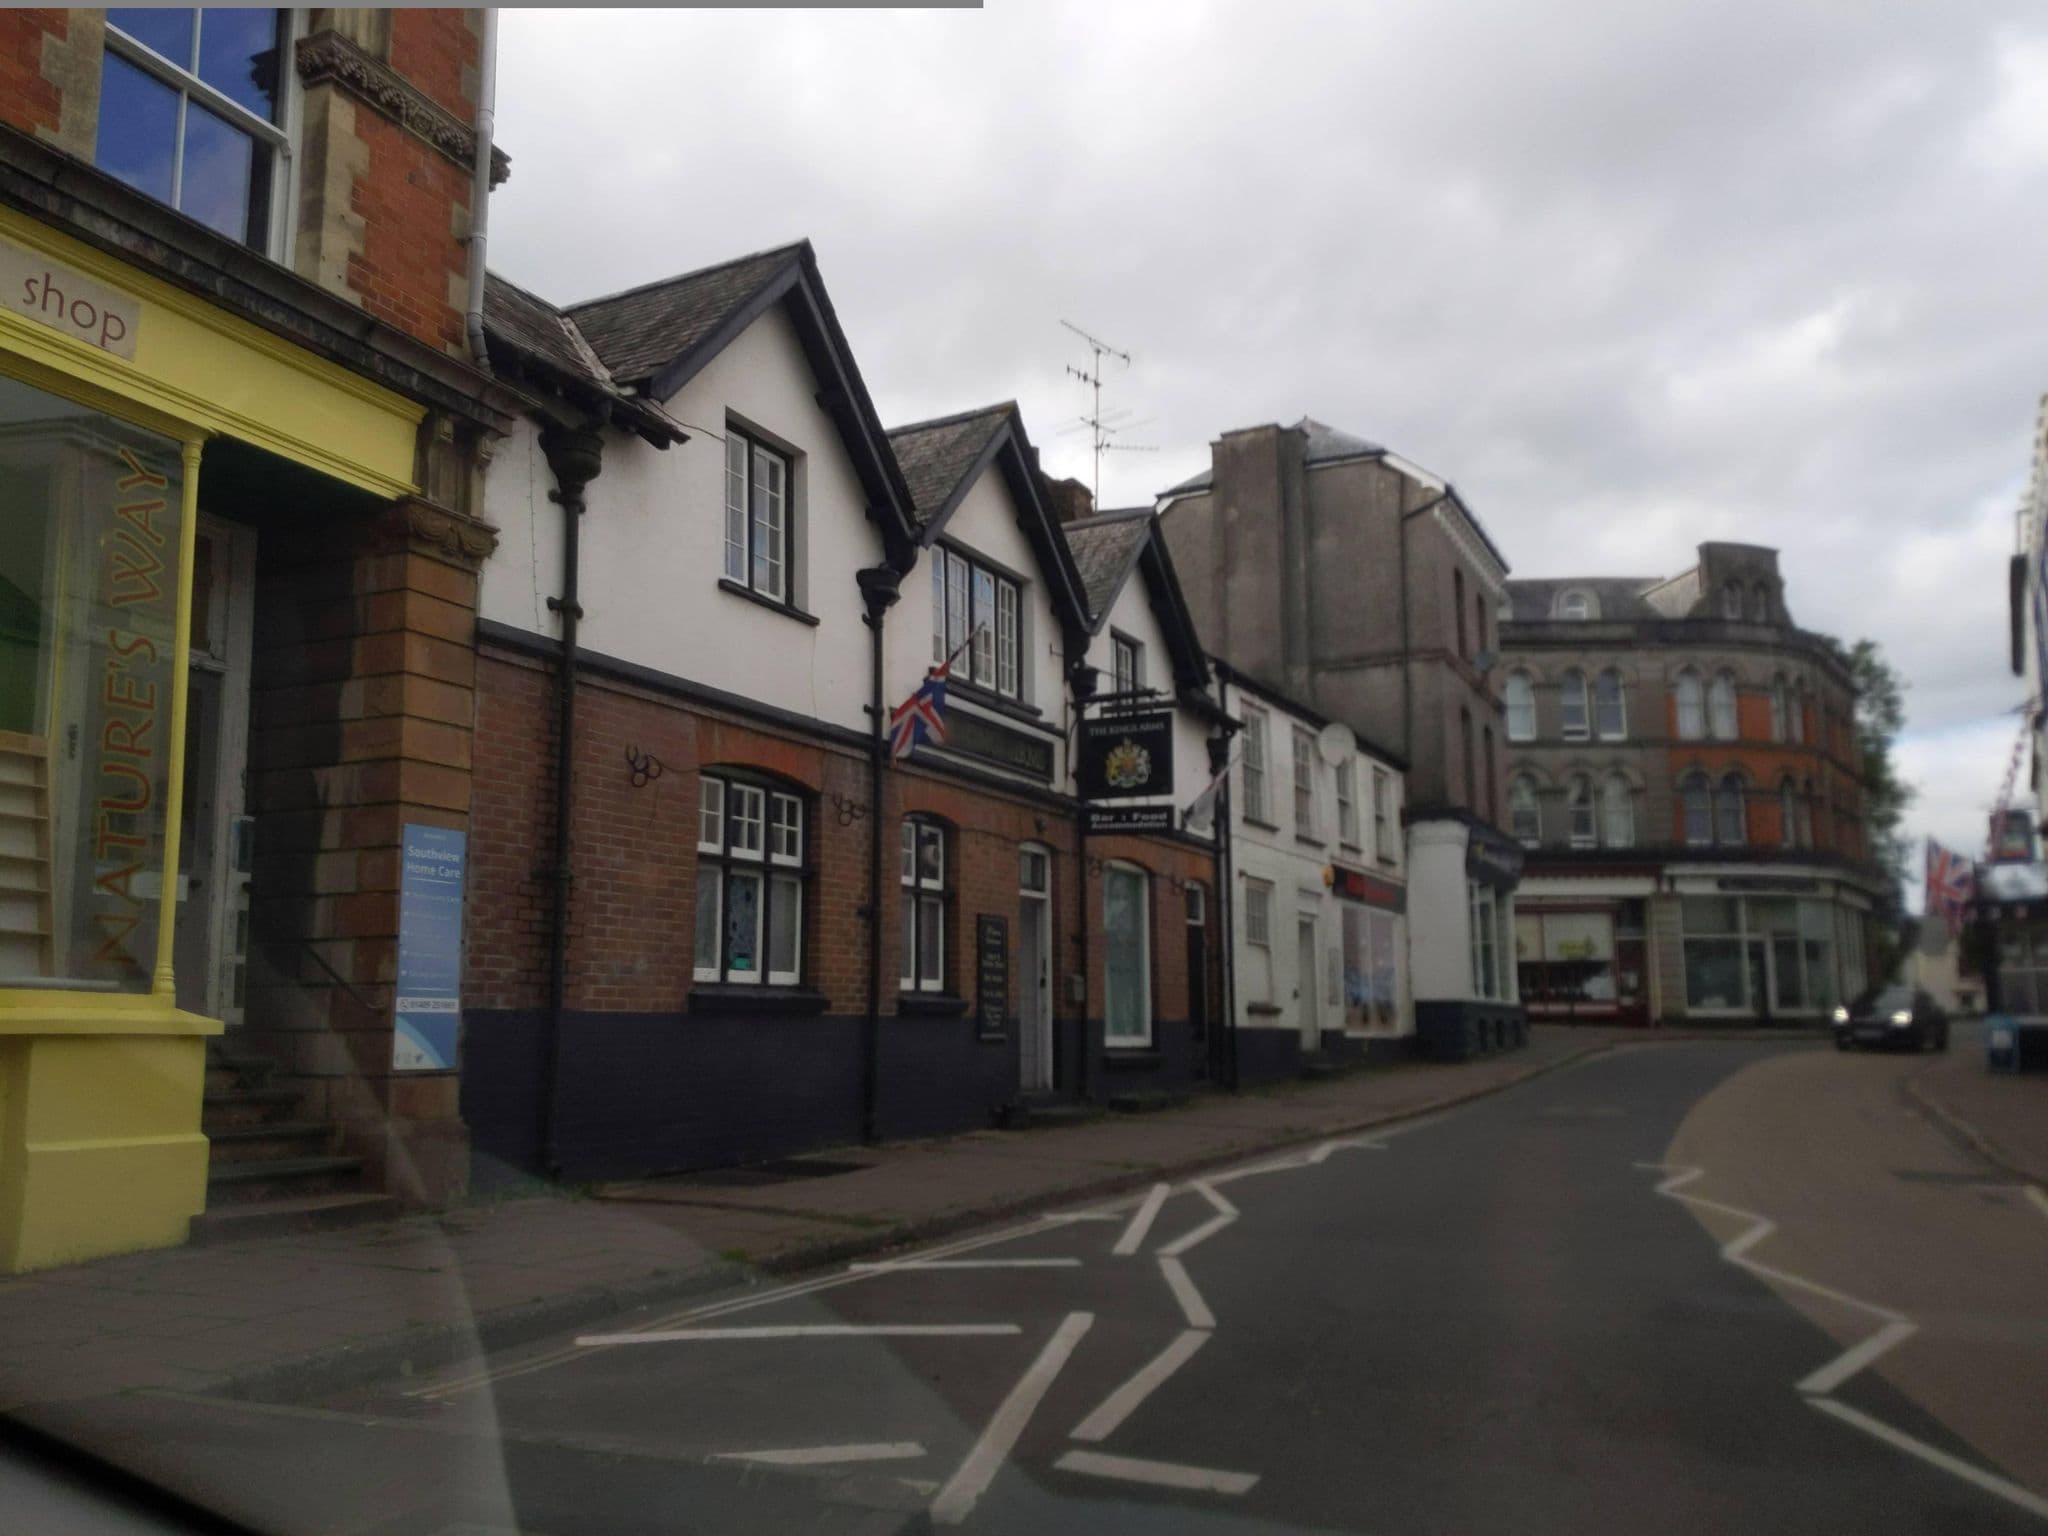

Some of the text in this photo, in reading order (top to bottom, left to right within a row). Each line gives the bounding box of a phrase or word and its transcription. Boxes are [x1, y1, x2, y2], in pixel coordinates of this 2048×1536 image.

[22, 272, 126, 347] shop
[92, 447, 169, 969] NATURE'S WAY
[1090, 812, 1168, 822] Bar Food
[407, 844, 461, 864] Southview
[406, 861, 462, 879] Home Care
